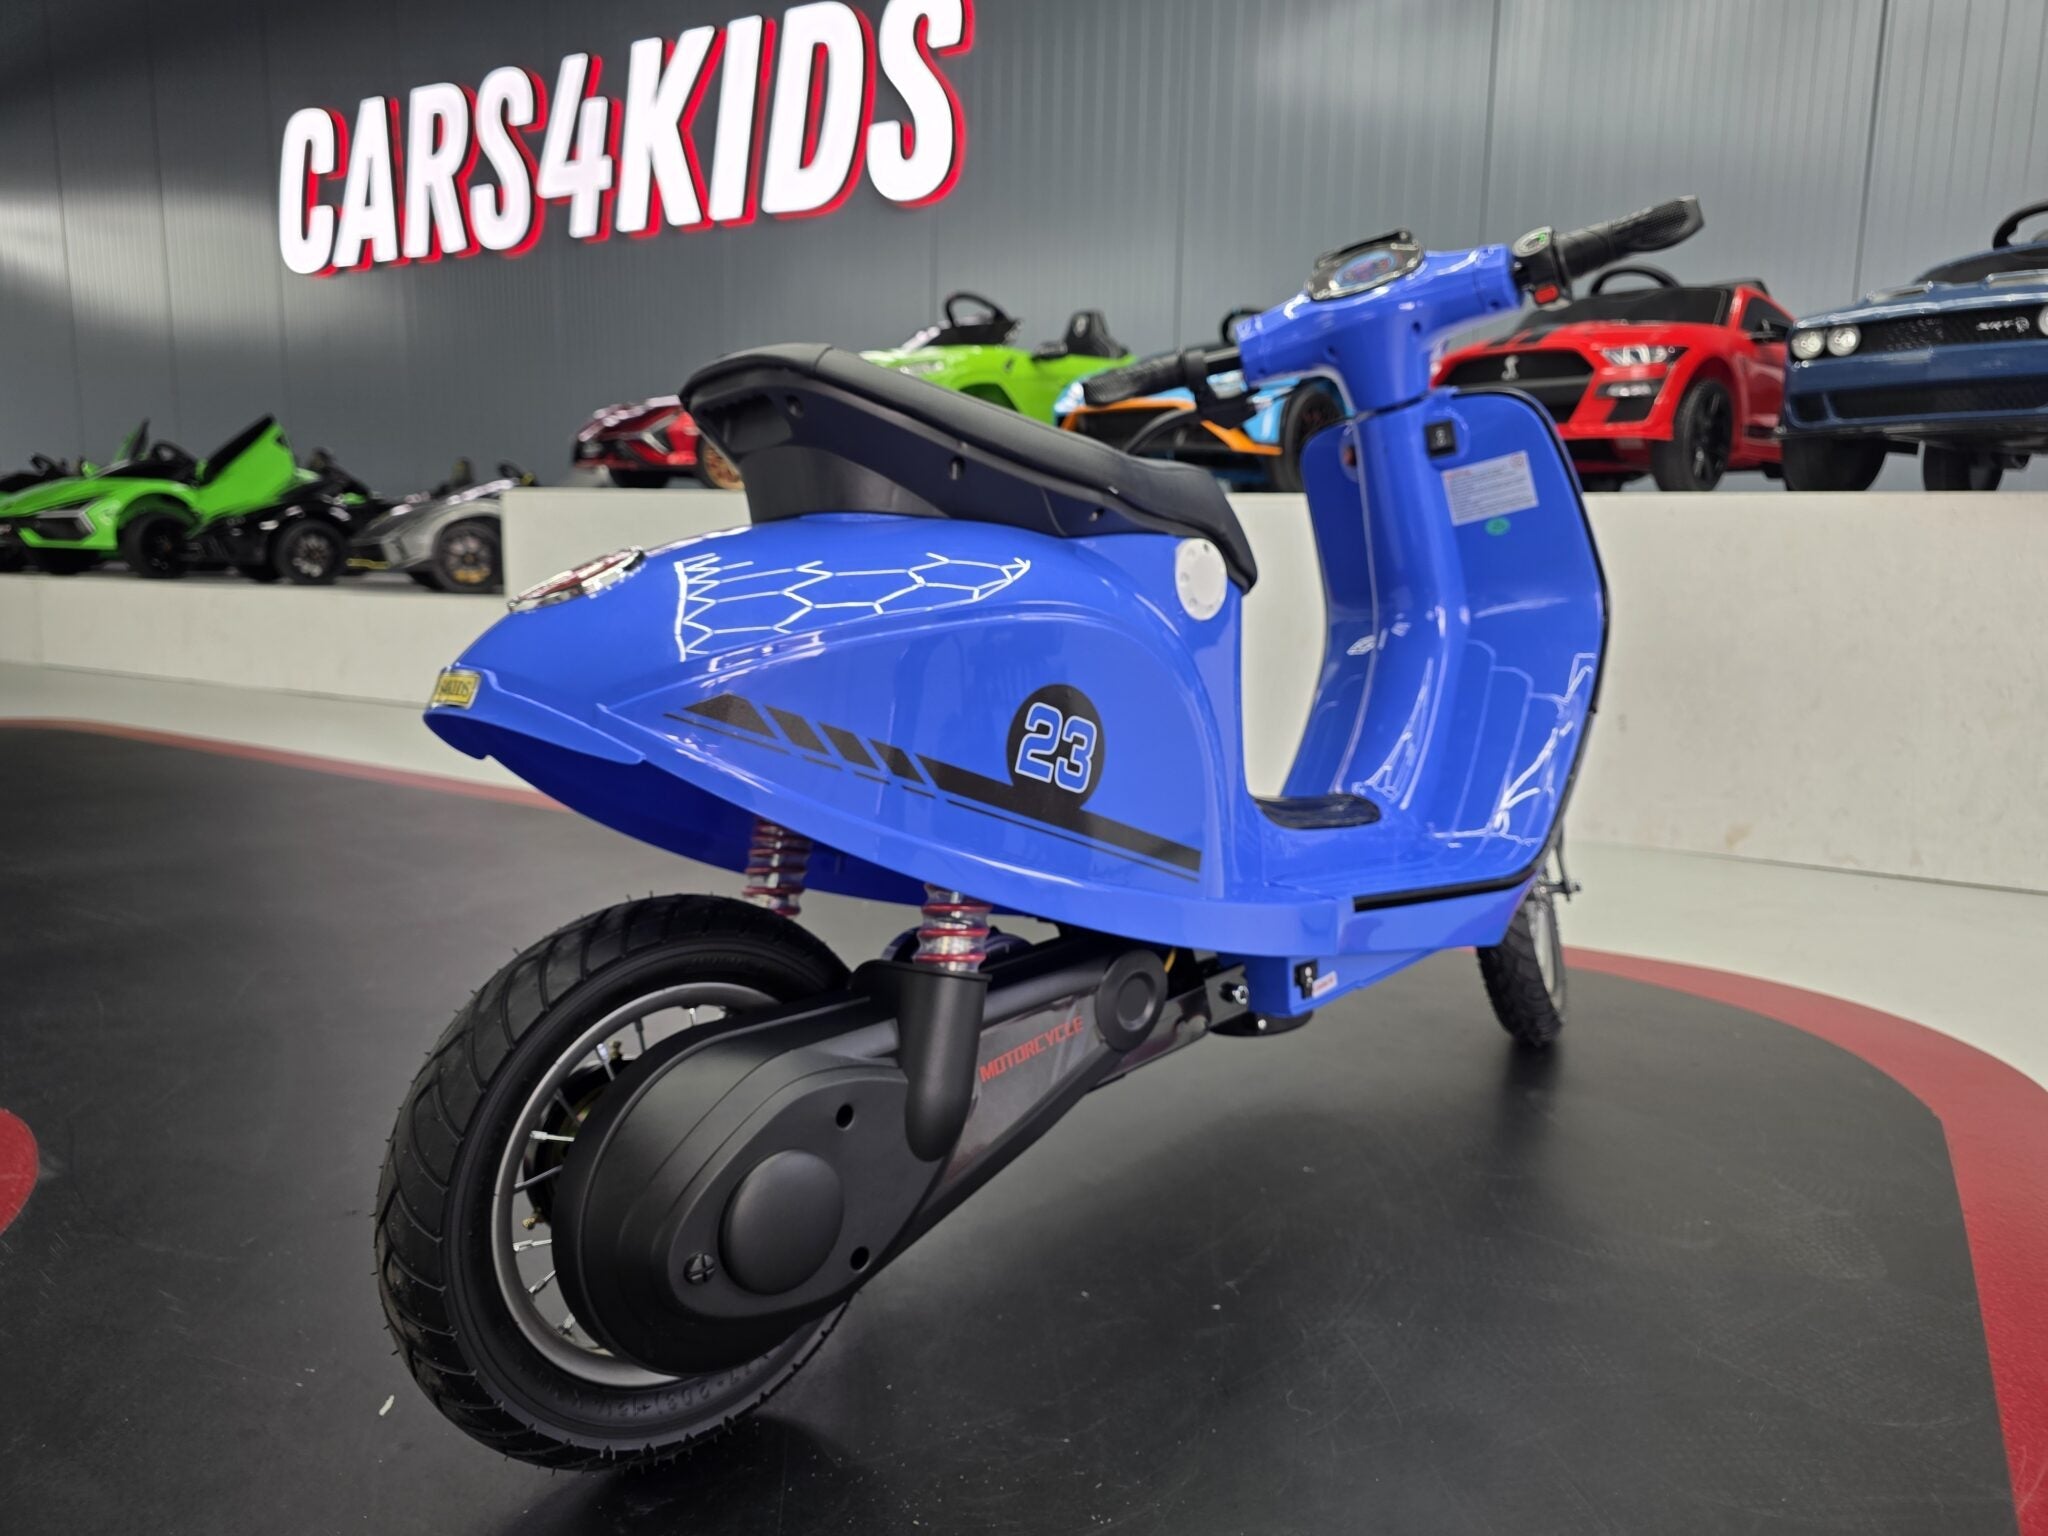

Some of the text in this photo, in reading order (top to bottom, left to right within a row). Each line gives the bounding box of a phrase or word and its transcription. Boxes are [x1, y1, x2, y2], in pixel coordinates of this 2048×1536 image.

[278, 0, 972, 276] CARS4KIDS
[1014, 701, 1098, 794] 23
[979, 1015, 1083, 1083] MOTORCYCLE
